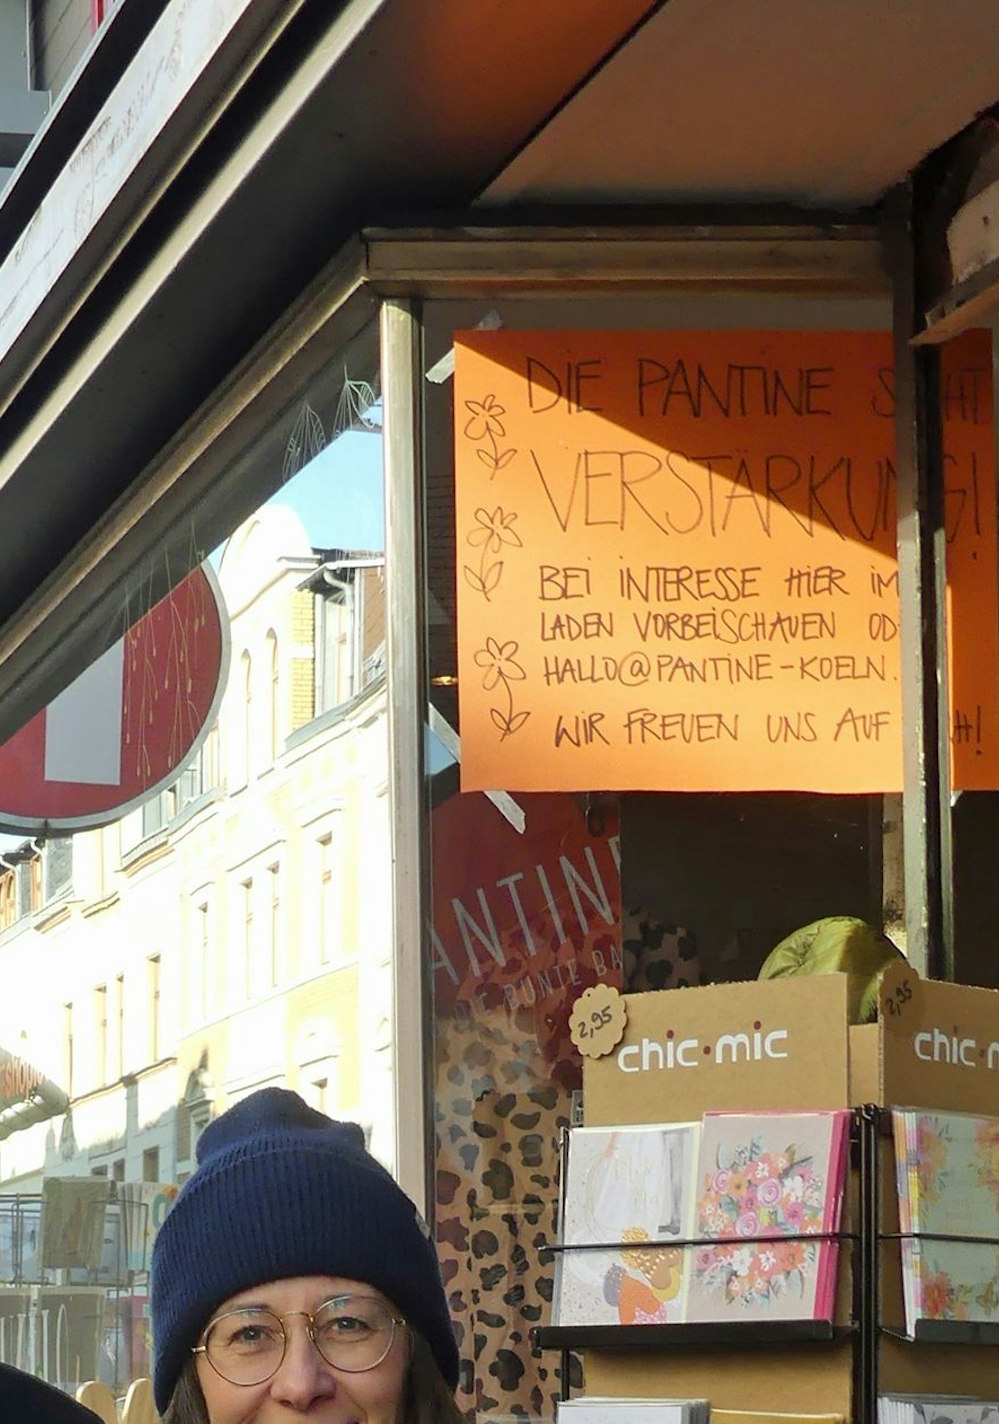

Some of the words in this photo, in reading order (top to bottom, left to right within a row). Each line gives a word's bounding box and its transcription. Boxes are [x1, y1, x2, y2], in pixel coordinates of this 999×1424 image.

[526, 348, 602, 414] DIE
[637, 350, 835, 419] PANTINE
[538, 556, 592, 601] BEI
[618, 555, 762, 602] INTERESSE
[784, 564, 850, 598] HIER
[540, 611, 614, 642] LADEN
[633, 606, 836, 645] VORBEISCHAUEN
[554, 711, 611, 748] WIR
[622, 707, 740, 745] FREUEN
[766, 711, 818, 743] UNS
[833, 706, 892, 742] AUF
[578, 1005, 613, 1039] 2,95
